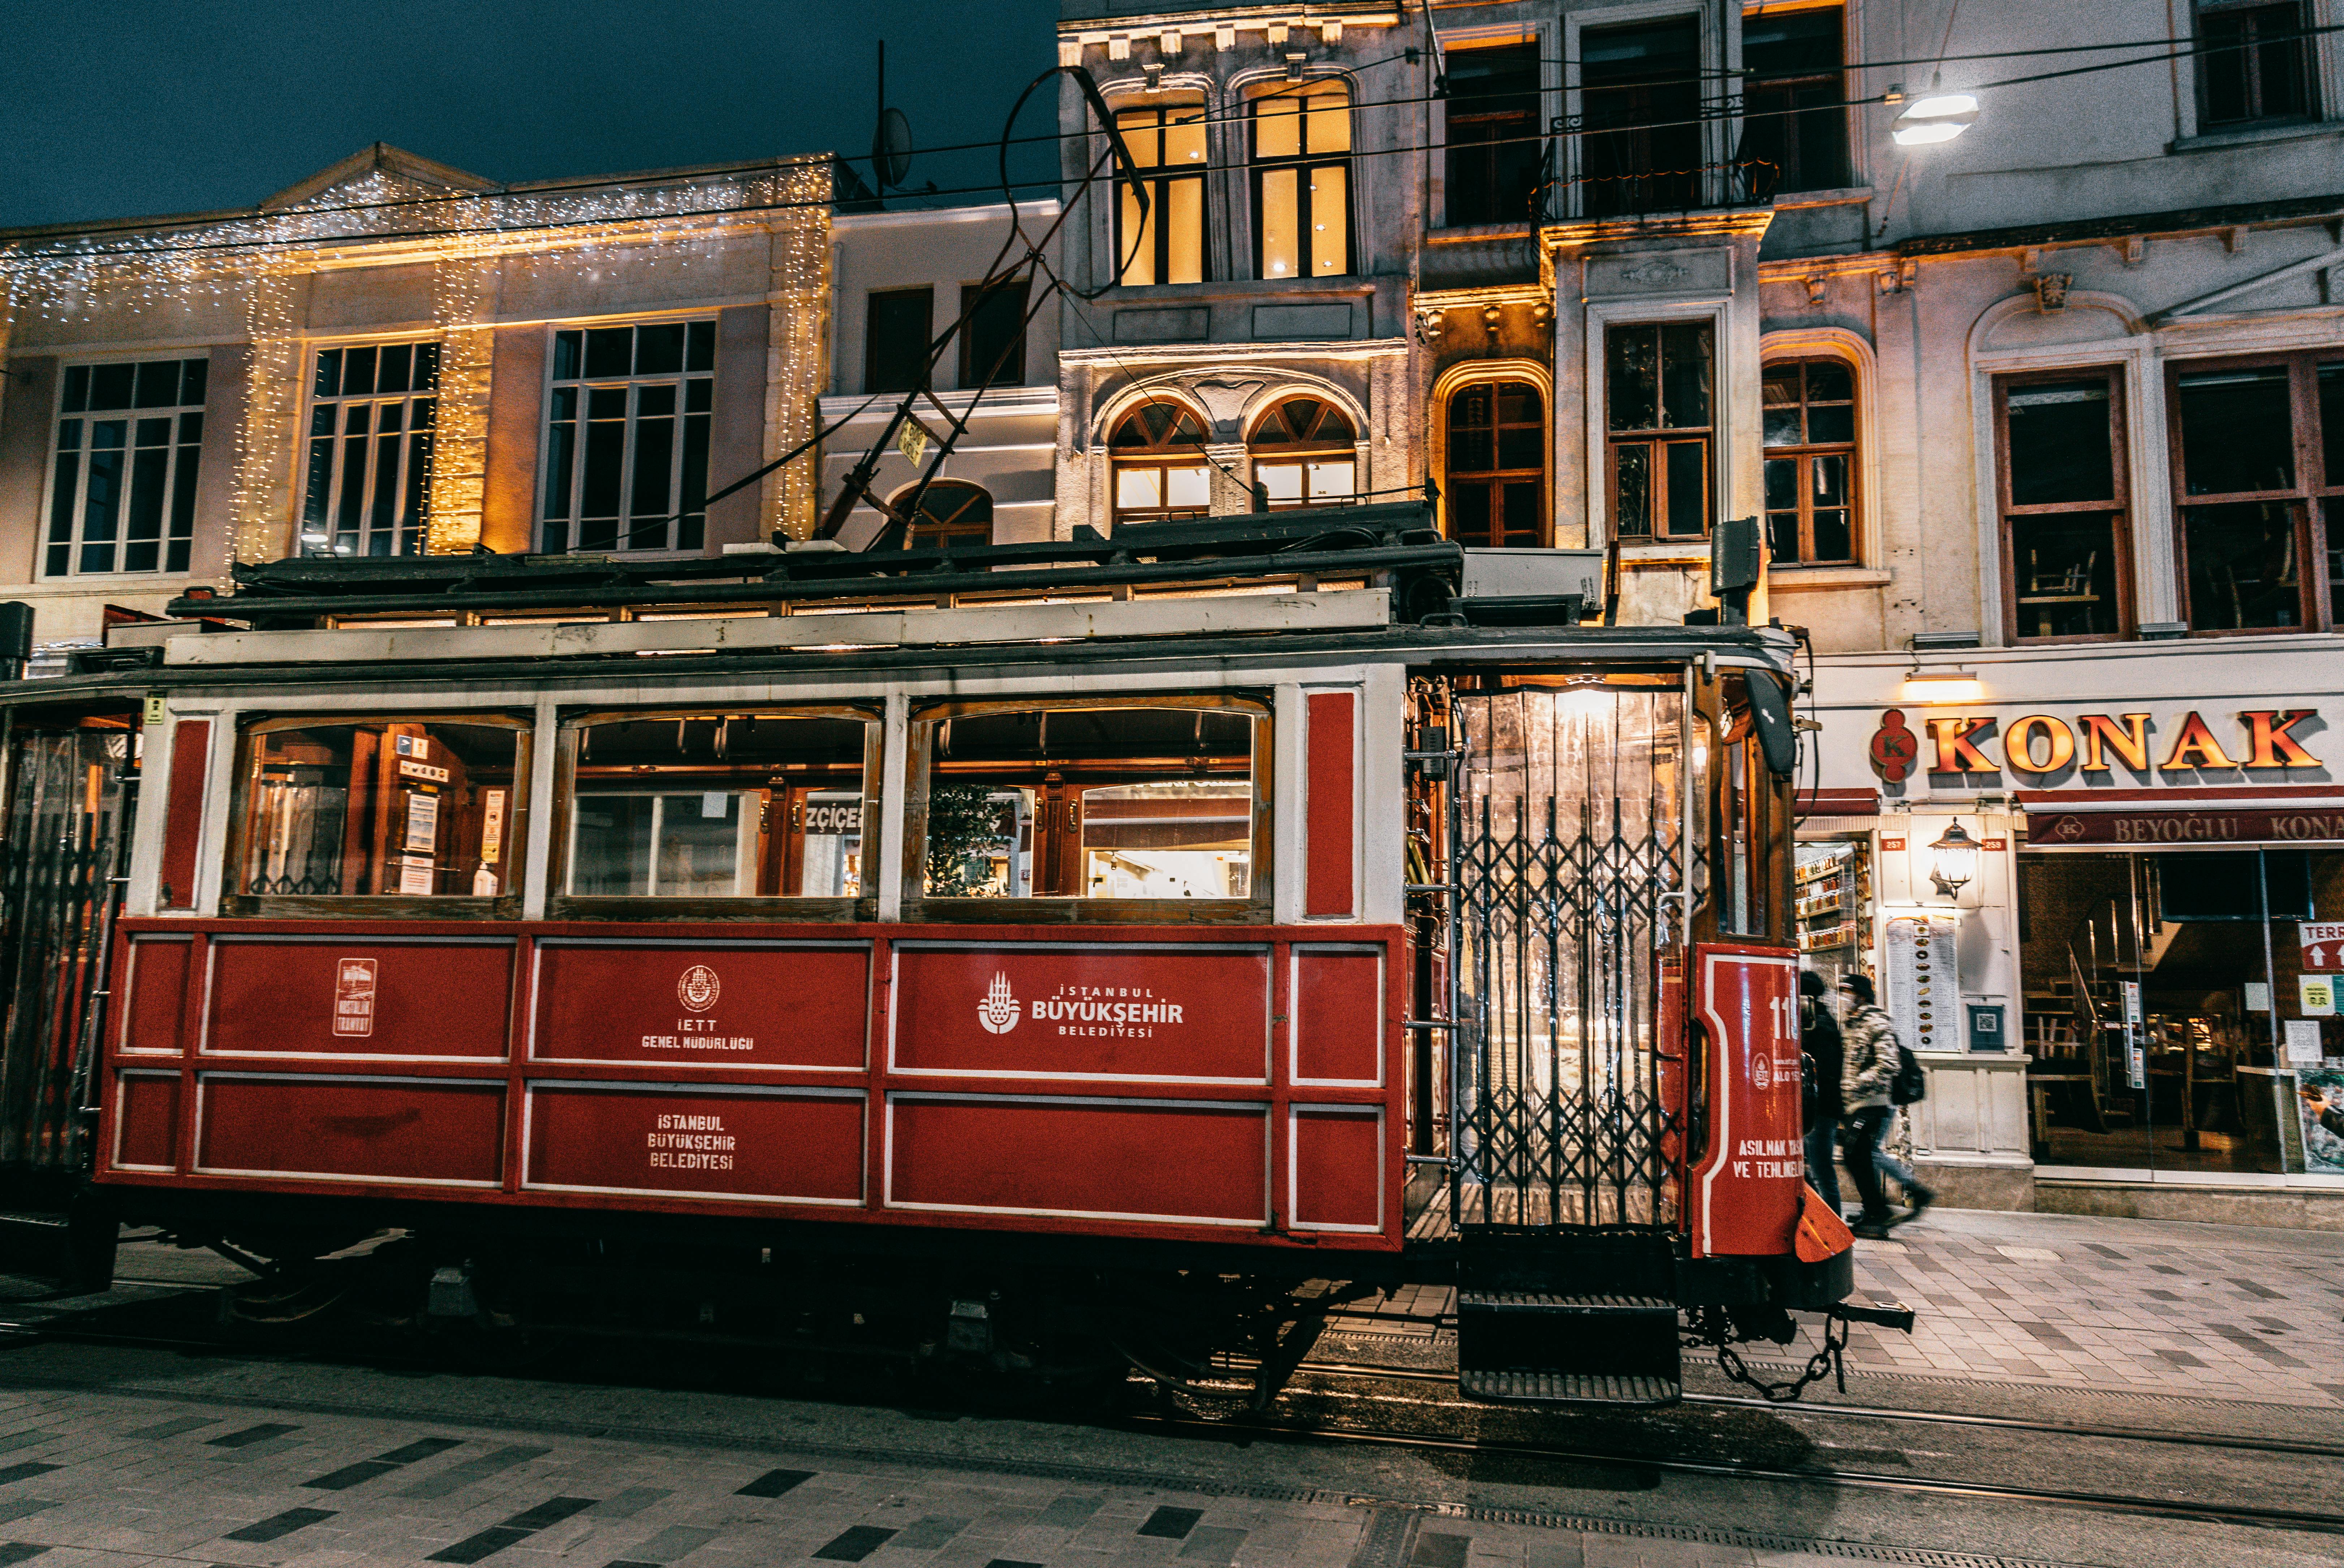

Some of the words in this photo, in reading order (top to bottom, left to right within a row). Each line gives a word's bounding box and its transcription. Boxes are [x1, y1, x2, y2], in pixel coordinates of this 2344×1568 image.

[1880, 735, 1908, 757] K
[1926, 709, 2323, 772] KONAK
[2114, 813, 2237, 843] BEYOĞLU
[1059, 983, 1153, 998] İSTANBUL
[1031, 995, 1183, 1028] BÜYÜKŞEHİR
[1058, 1025, 1152, 1038] BELEDİYESİ
[642, 1036, 680, 1048] GENEL
[658, 1114, 724, 1131] İSTANBUL
[647, 1133, 736, 1151] BÜYÜKŞEHİR
[650, 1153, 733, 1170] BELEDİYESİ
[1733, 1161, 1751, 1178] VE
